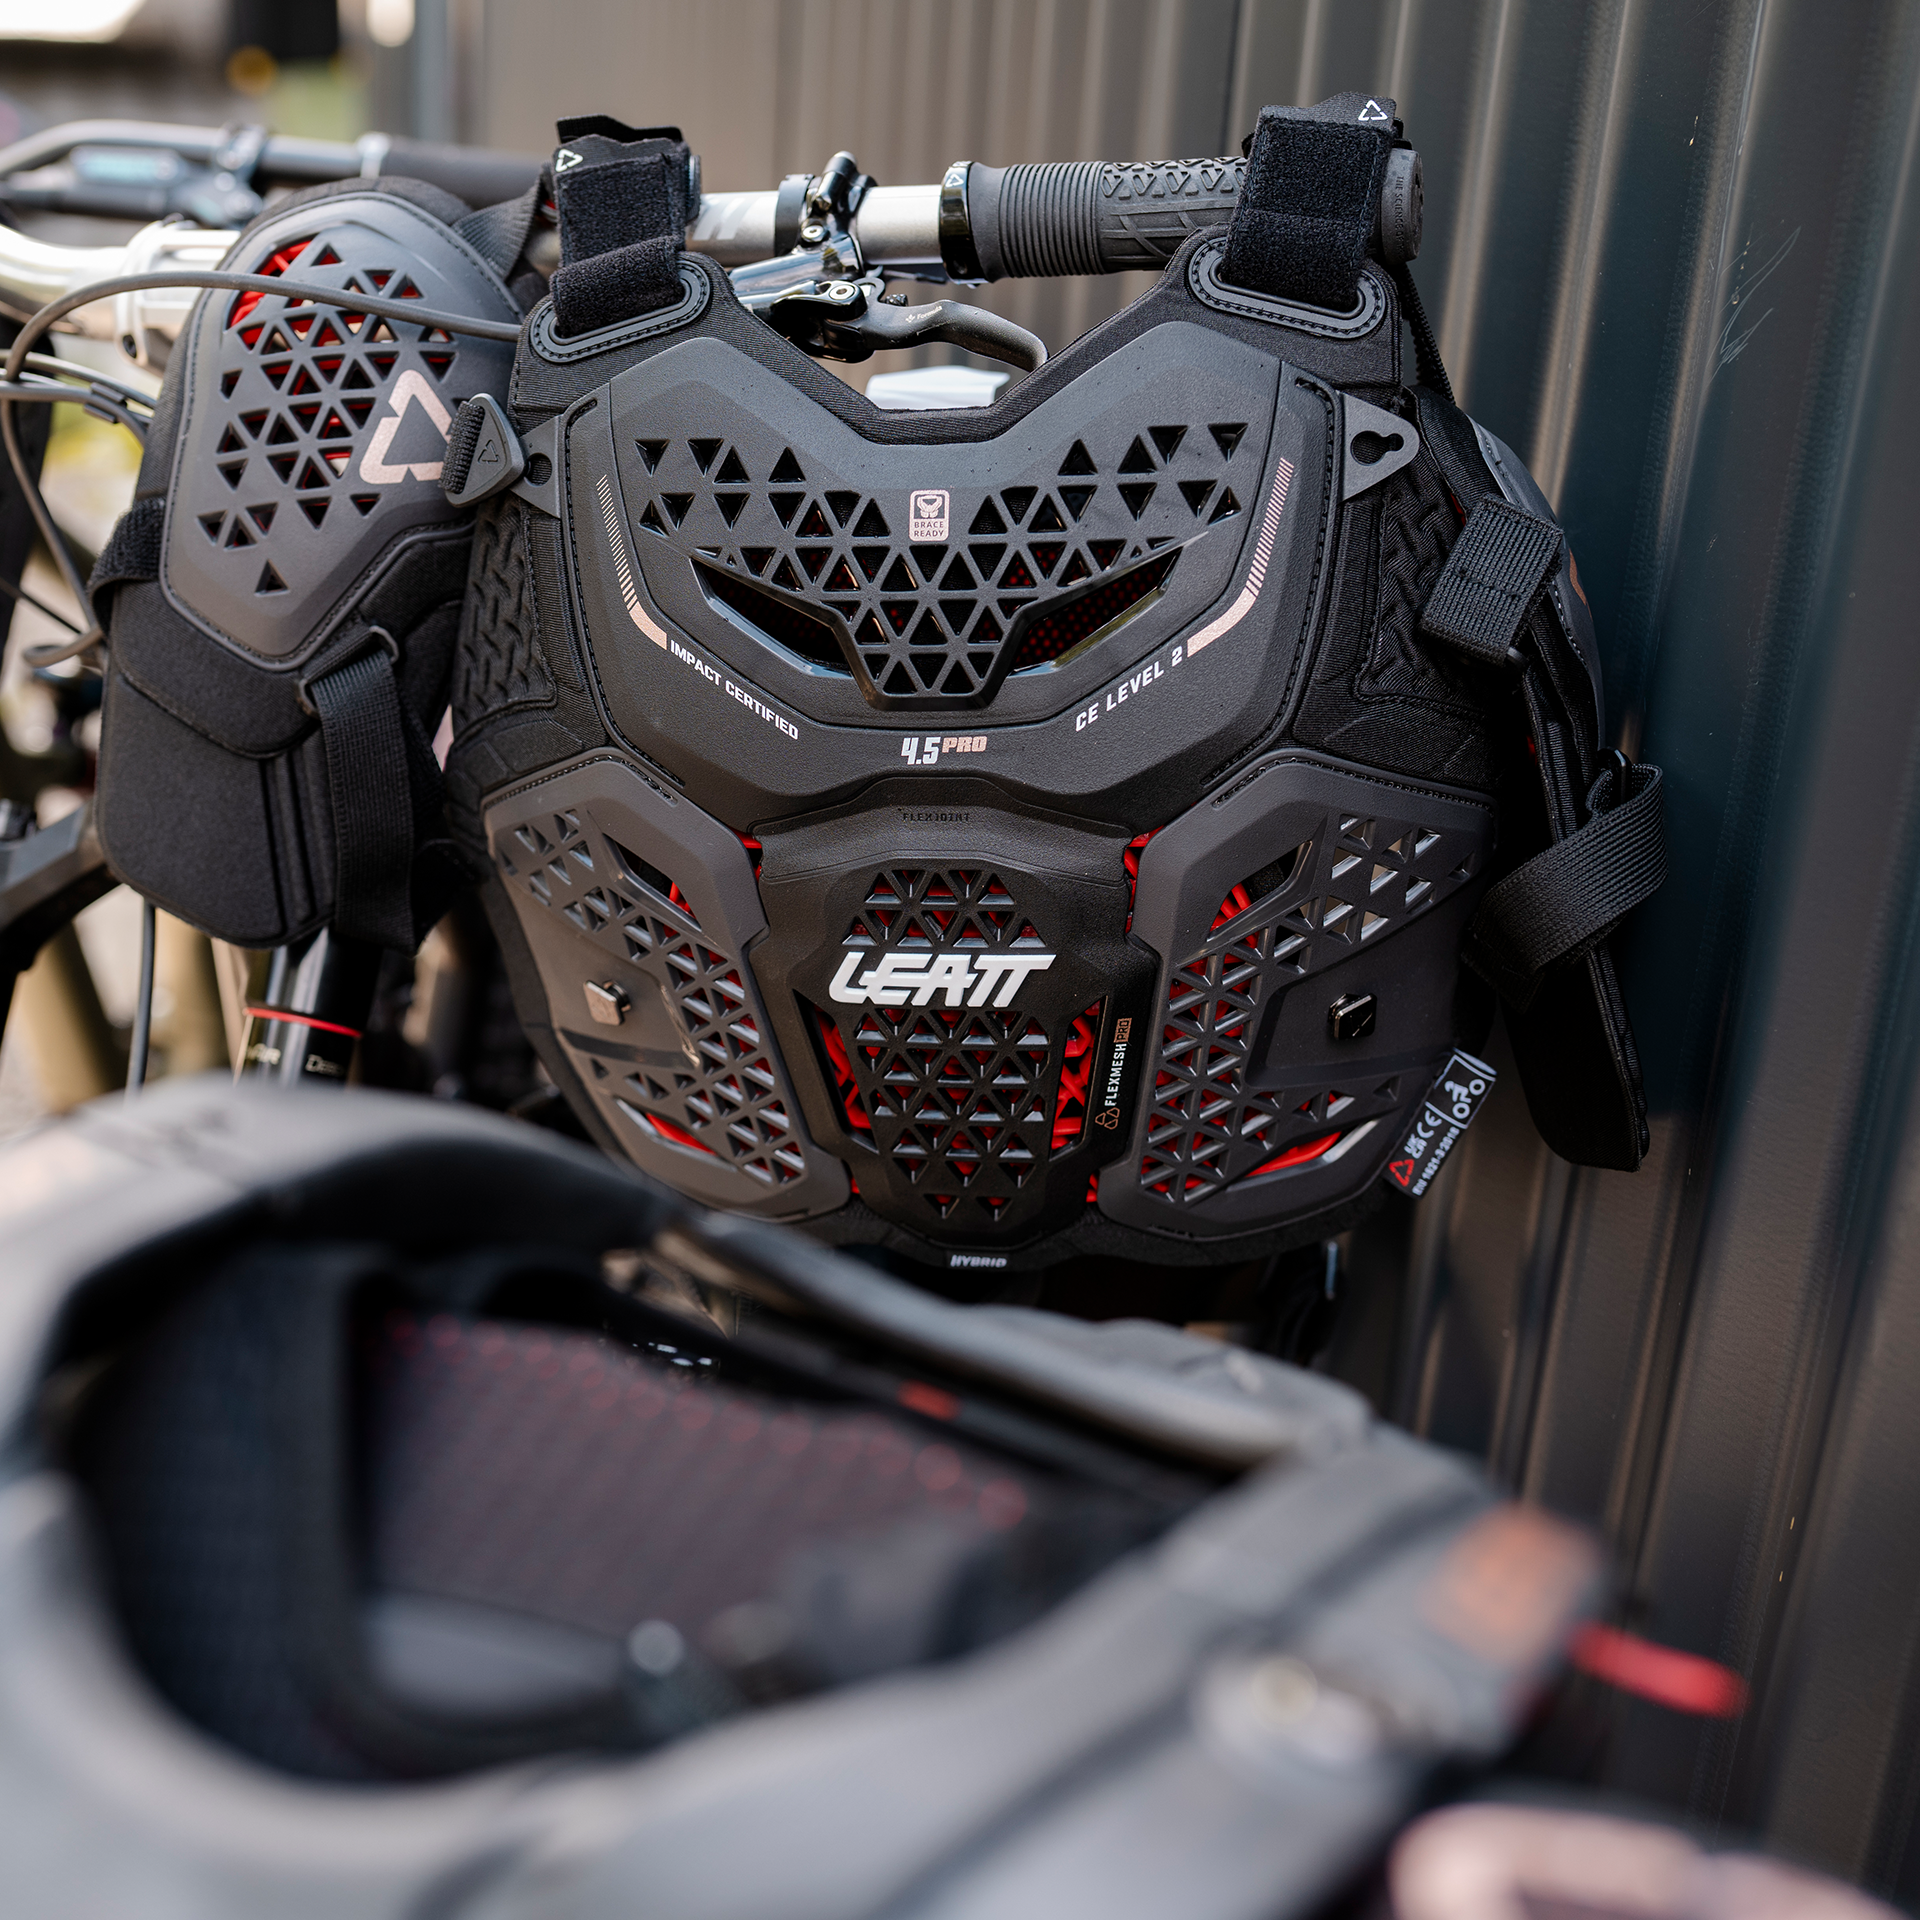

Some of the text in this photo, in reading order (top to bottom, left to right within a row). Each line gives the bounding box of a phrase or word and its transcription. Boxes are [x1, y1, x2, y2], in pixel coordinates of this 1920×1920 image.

[1394, 193, 1404, 229] SCIENCE
[670, 639, 799, 740] IMPACT CERTIFIED
[1075, 645, 1183, 732] CE LEVEL 2
[828, 951, 1057, 1008] LEATT
[1104, 1020, 1130, 1107] FLEXMESH PRO
[950, 1254, 1007, 1268] HYBRID
